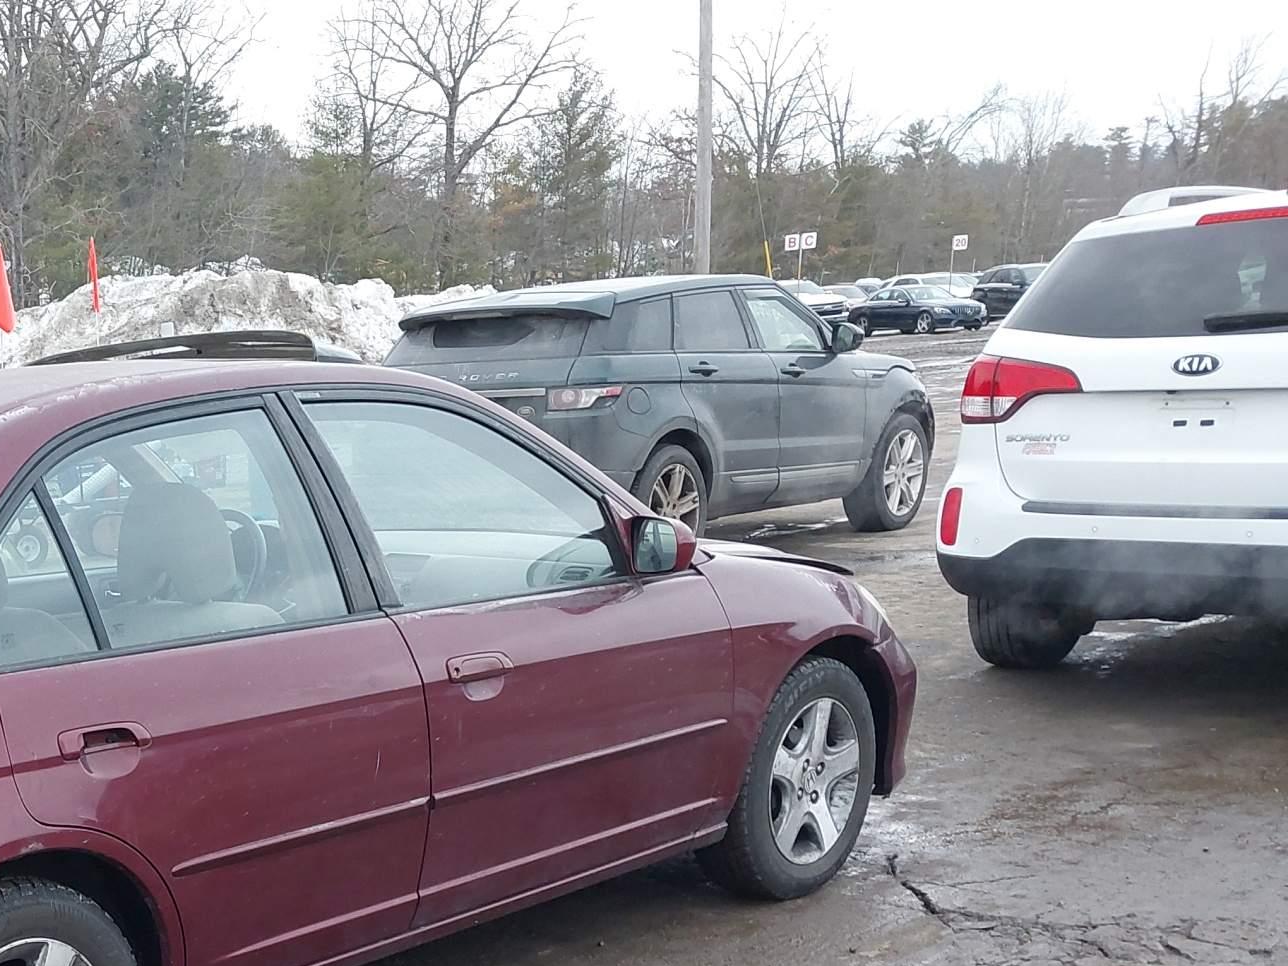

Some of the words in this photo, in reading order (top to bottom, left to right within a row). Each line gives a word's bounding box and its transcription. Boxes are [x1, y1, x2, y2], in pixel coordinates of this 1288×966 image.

[788, 236, 797, 248] B
[803, 234, 814, 246] C
[953, 238, 967, 248] 20
[1178, 356, 1213, 372] KIA
[1005, 433, 1071, 443] SORENTO
